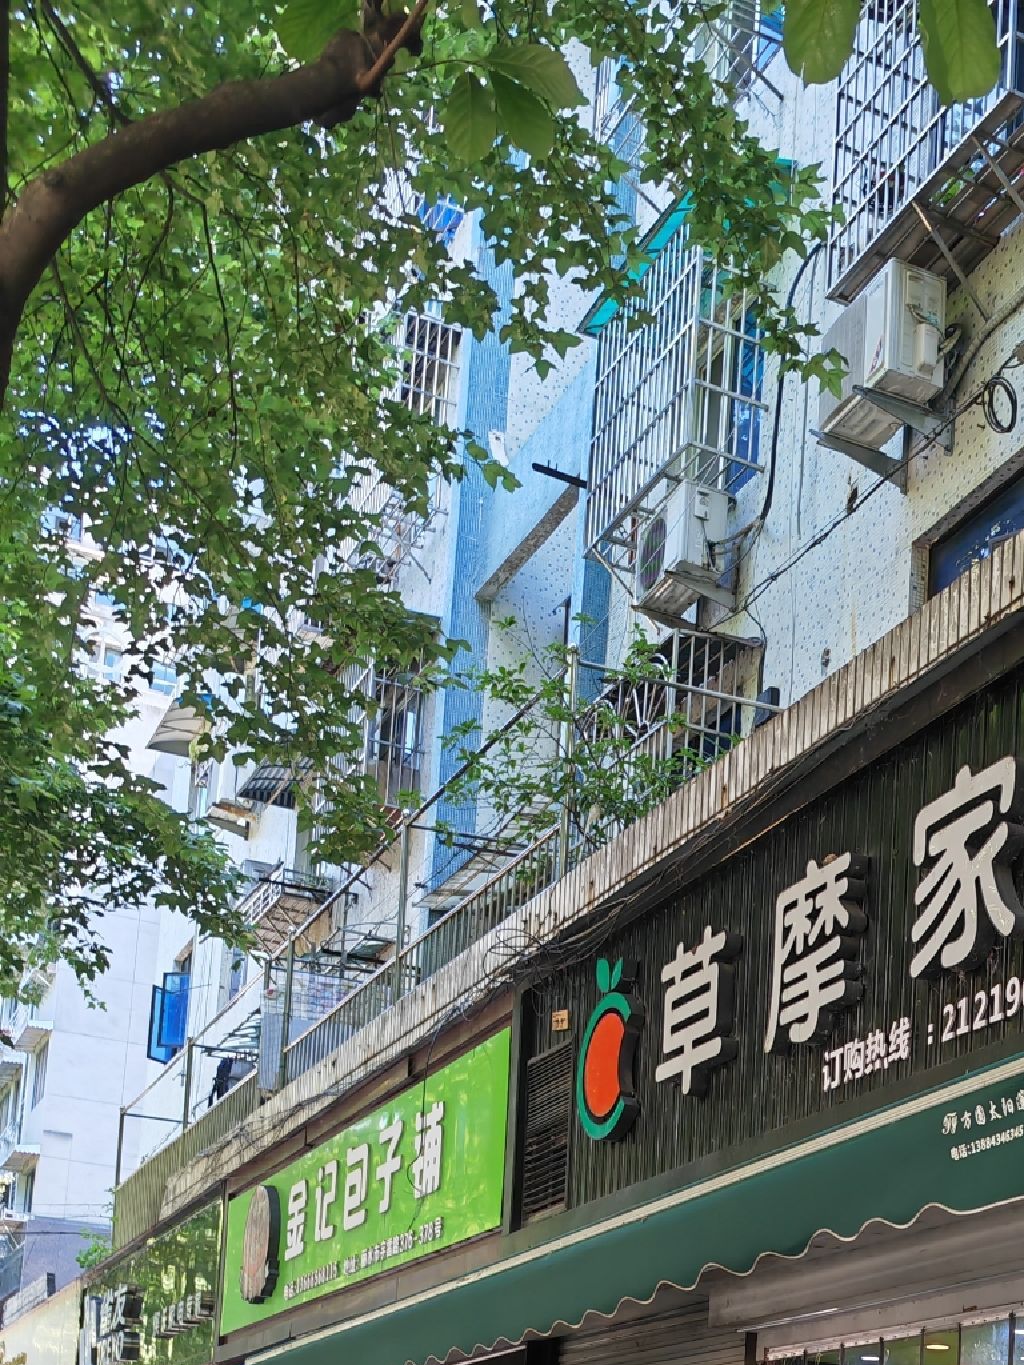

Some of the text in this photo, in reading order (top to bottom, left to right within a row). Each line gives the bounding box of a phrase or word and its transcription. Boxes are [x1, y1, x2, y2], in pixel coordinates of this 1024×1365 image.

[655, 755, 1017, 1095] 草摩家
[284, 1101, 444, 1262] 金记包子铺
